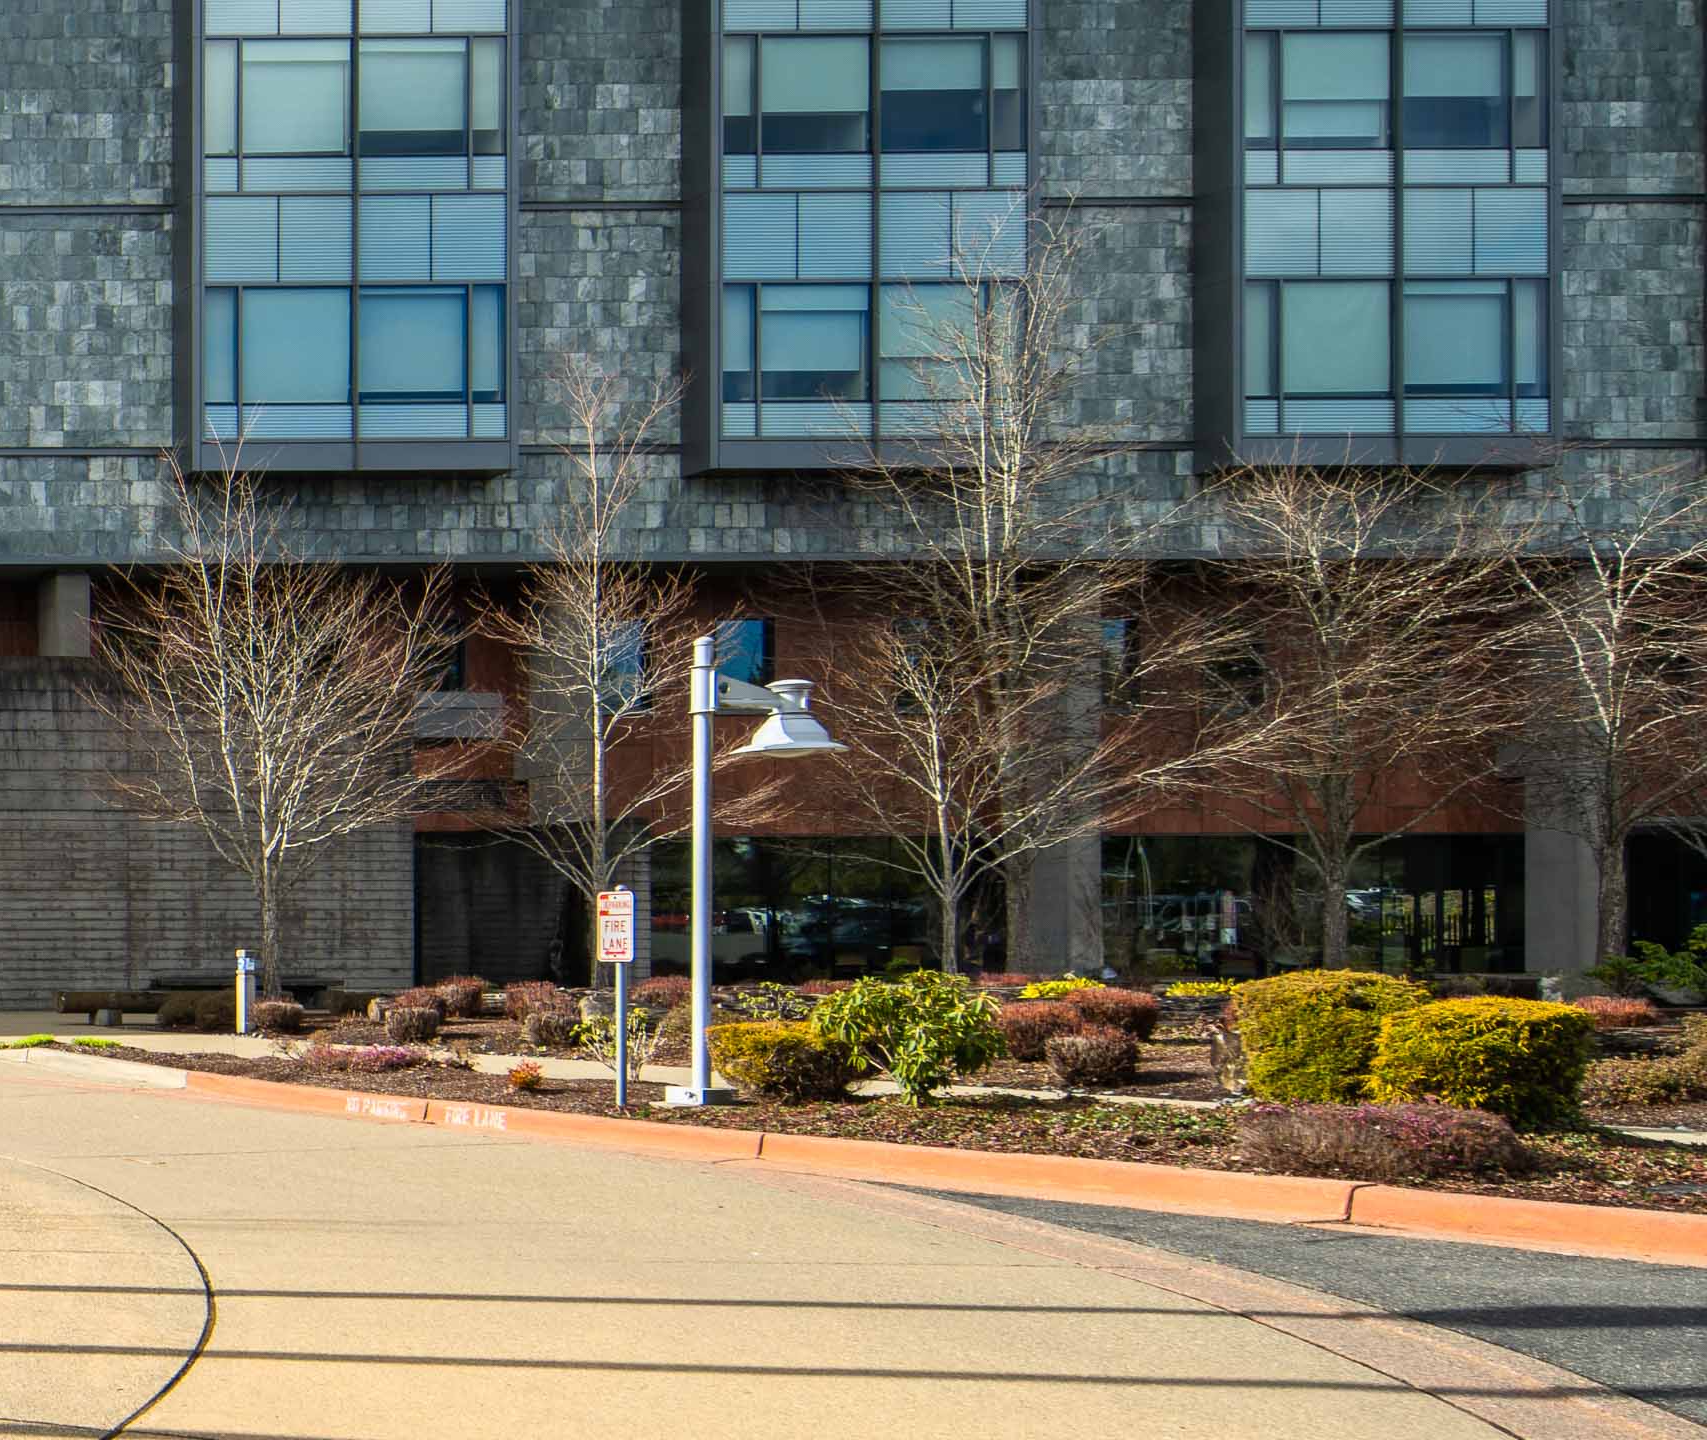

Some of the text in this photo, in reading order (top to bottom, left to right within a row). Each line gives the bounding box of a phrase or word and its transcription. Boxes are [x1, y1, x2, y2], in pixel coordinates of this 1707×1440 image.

[604, 920, 626, 933] FIRE
[602, 937, 628, 951] LANE
[473, 1109, 507, 1131] LANE
